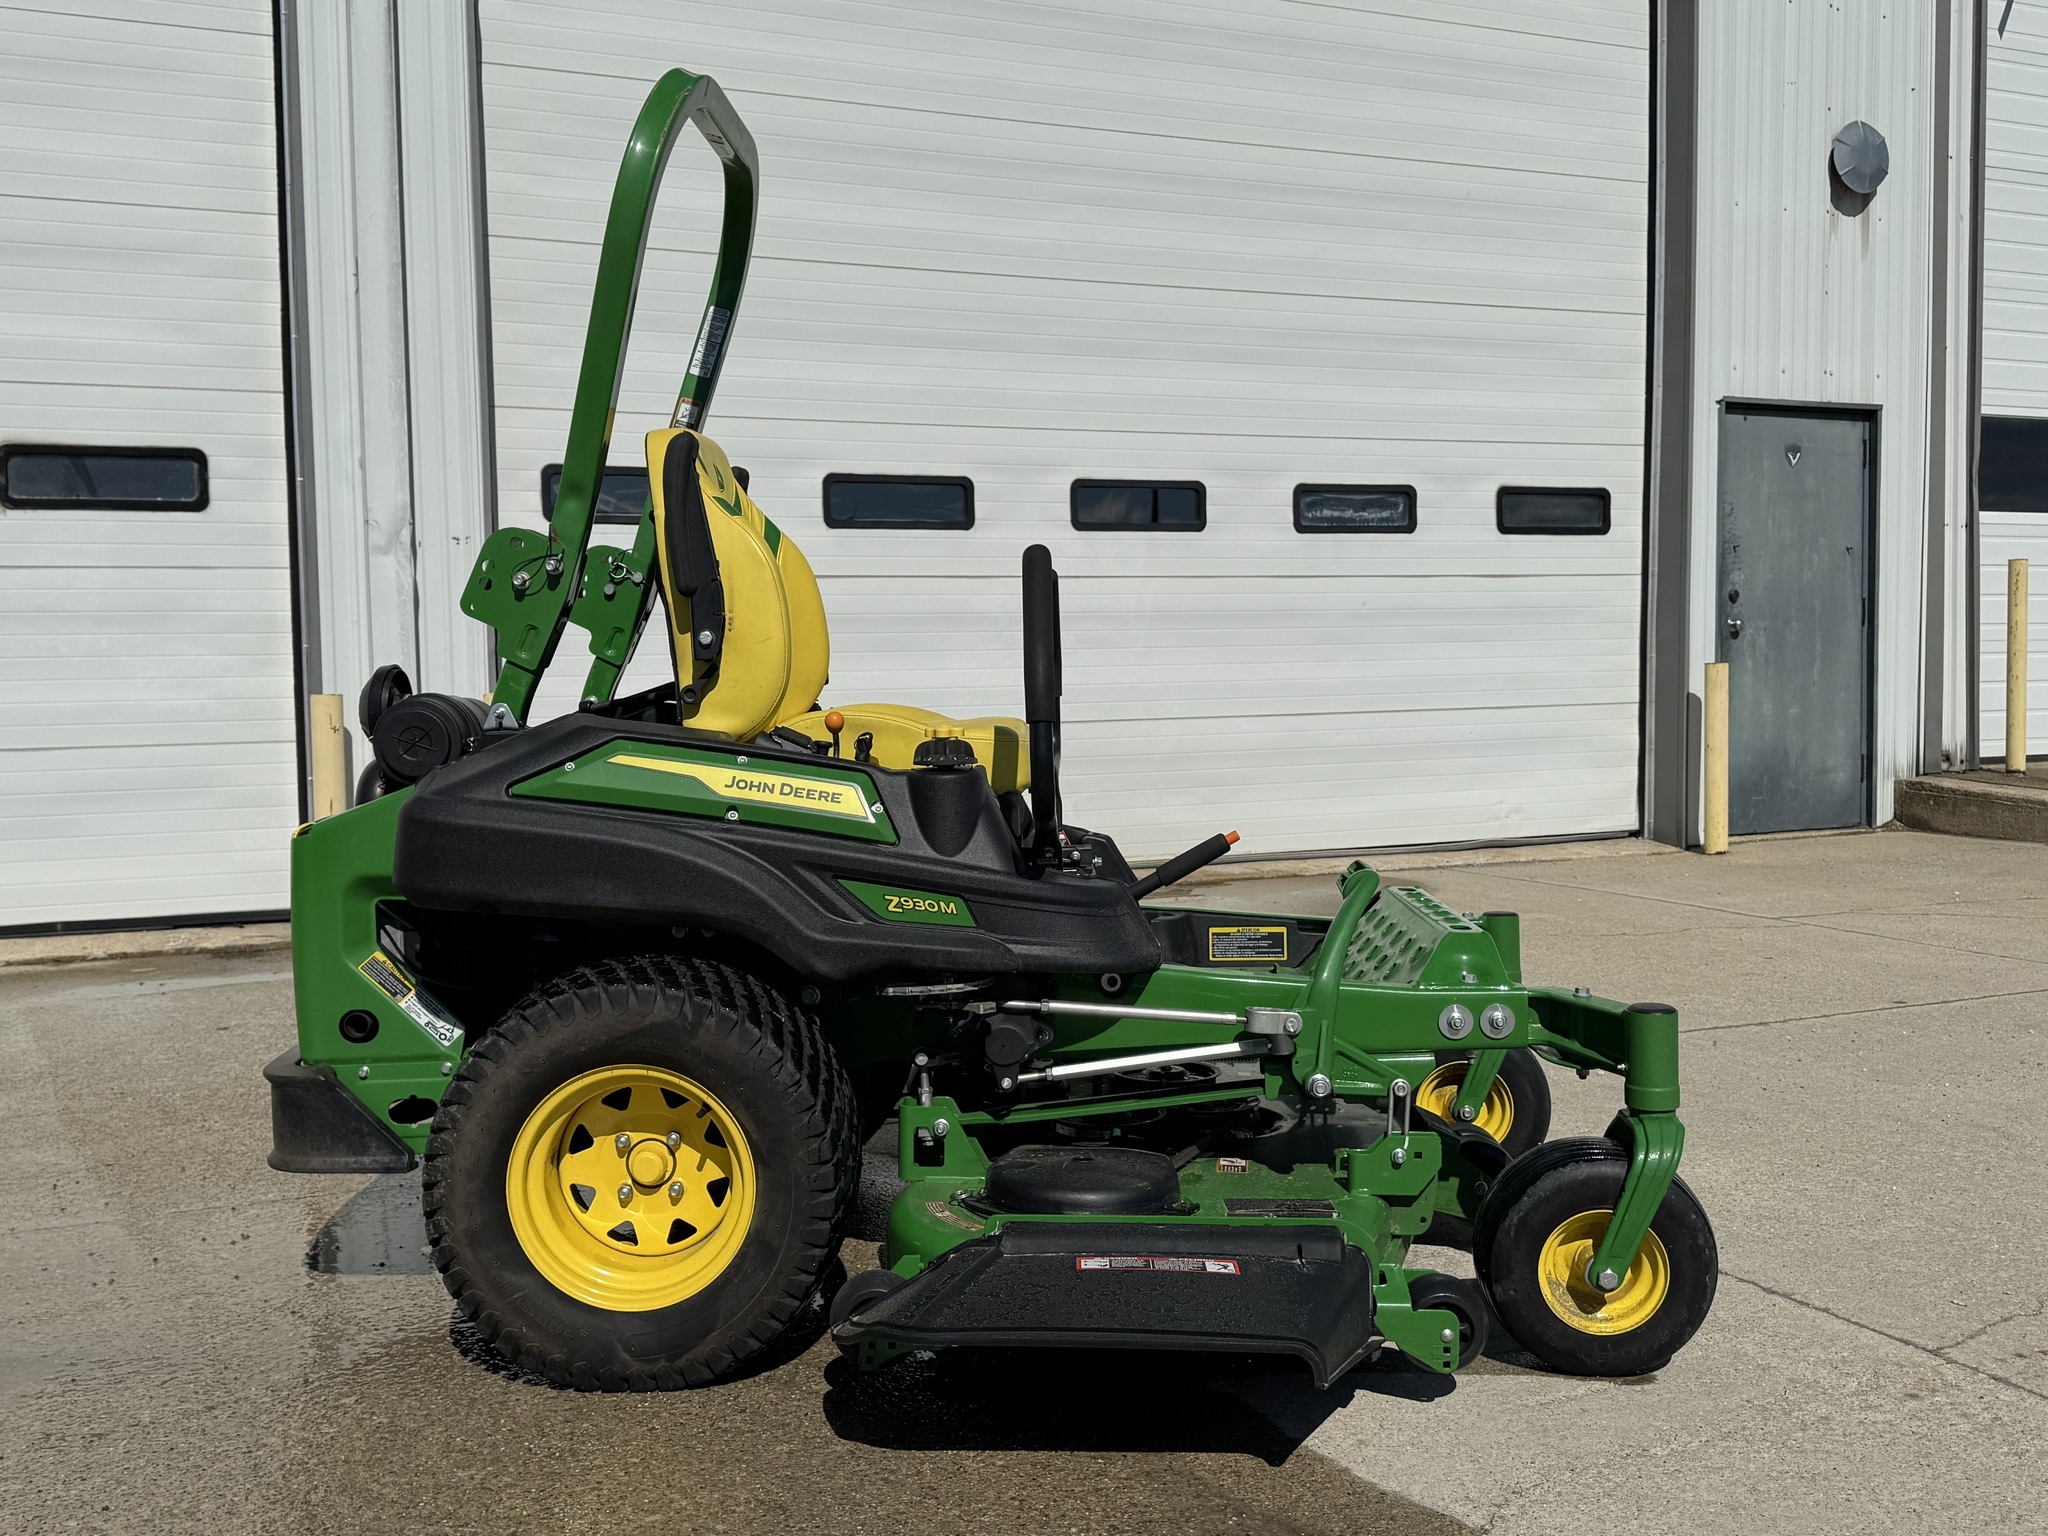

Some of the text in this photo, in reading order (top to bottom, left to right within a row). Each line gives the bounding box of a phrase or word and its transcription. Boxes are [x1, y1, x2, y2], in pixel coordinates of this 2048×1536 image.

[724, 775, 843, 804] JOHN DEERE
[884, 895, 958, 915] Z930M
